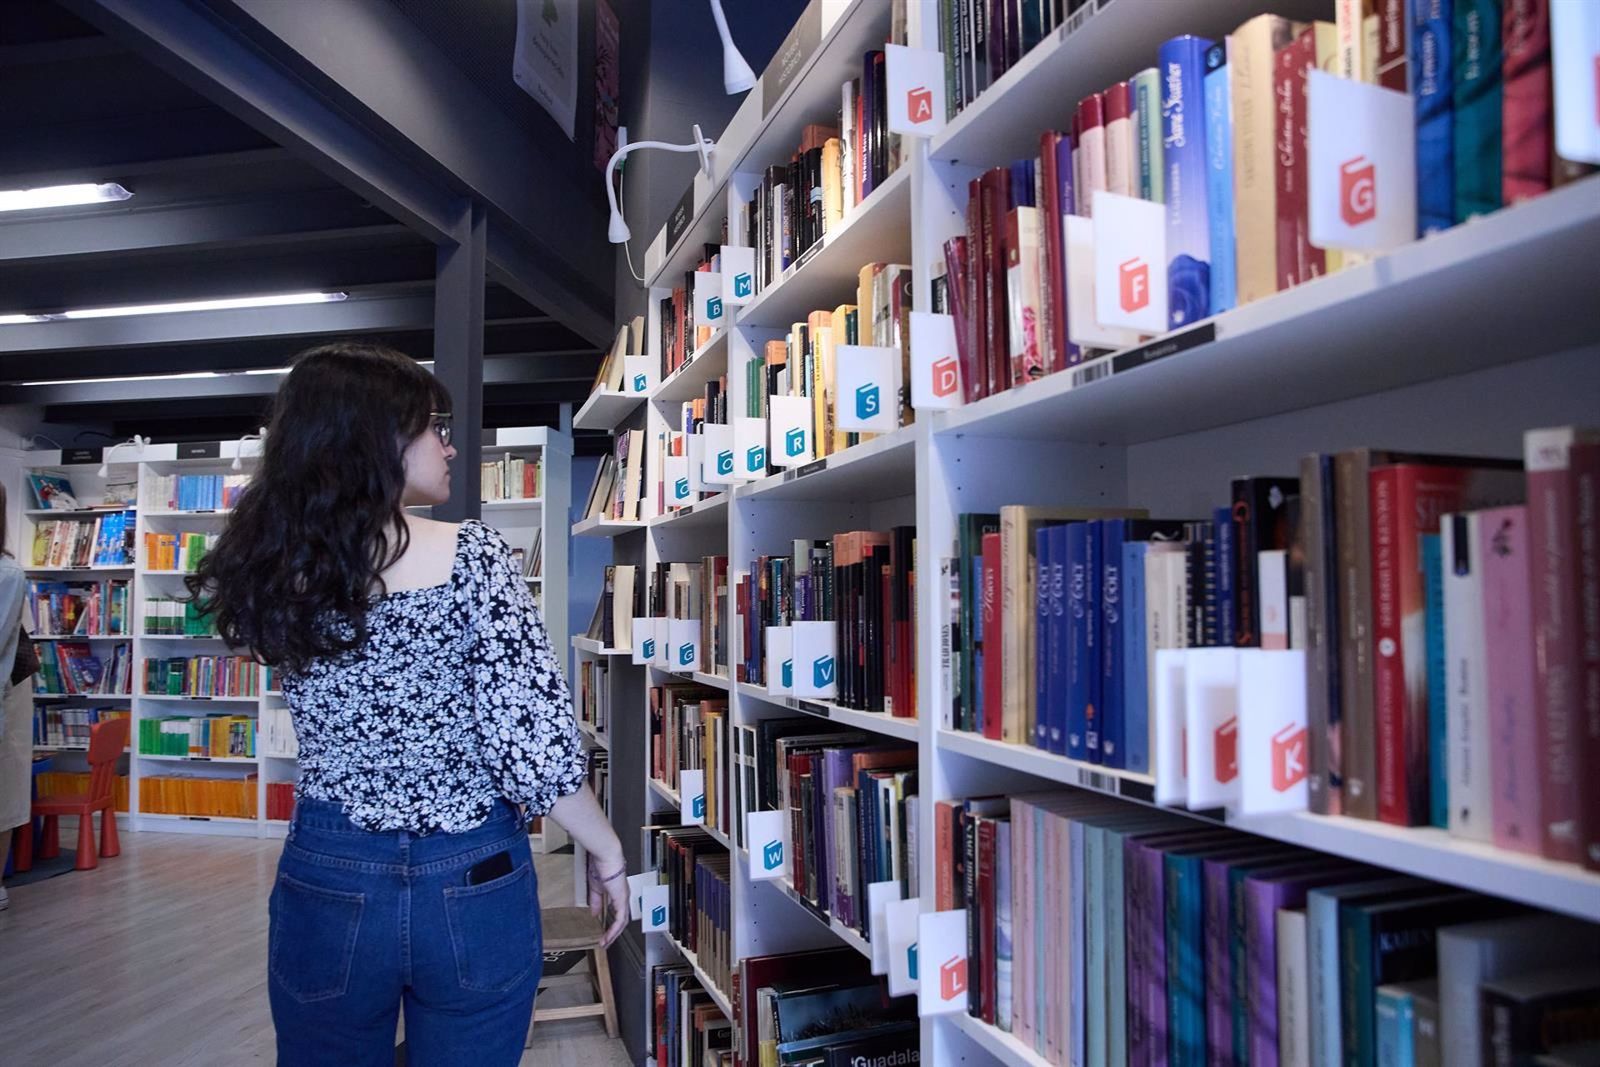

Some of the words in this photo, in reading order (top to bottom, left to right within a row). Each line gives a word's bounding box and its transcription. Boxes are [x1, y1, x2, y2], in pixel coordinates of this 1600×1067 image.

[916, 99, 931, 116] A
[1350, 178, 1373, 214] G
[739, 279, 751, 294] M
[1131, 274, 1145, 302] F
[713, 304, 721, 315] B
[638, 379, 647, 389] A
[941, 366, 957, 391] D
[865, 394, 876, 413] S
[793, 436, 803, 452] R
[722, 458, 733, 471] O
[754, 454, 762, 467] P
[649, 644, 655, 655] E
[684, 649, 693, 661] G
[820, 664, 833, 681] V
[1286, 741, 1303, 781] K
[768, 847, 783, 865] W
[952, 970, 961, 989] L
